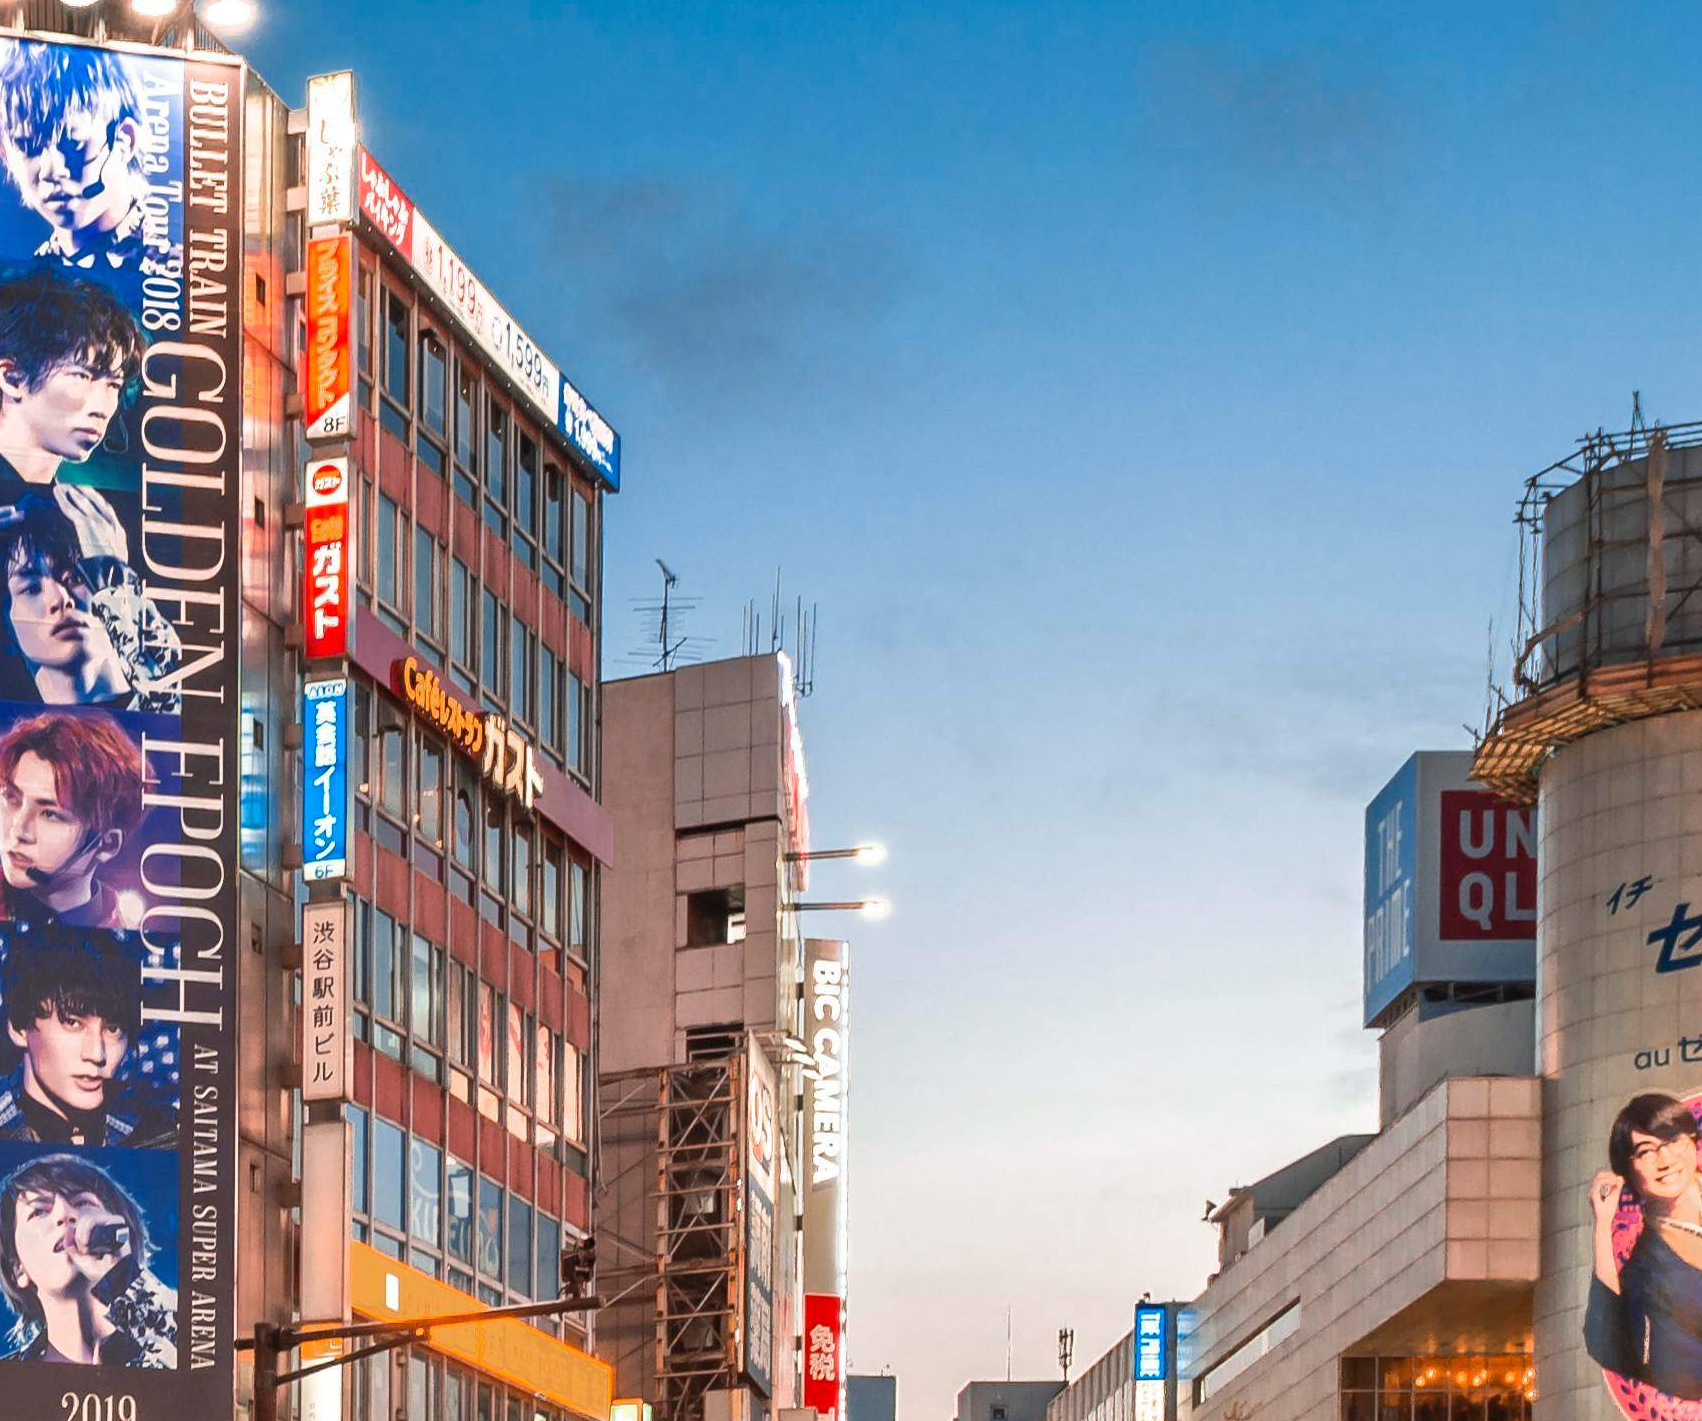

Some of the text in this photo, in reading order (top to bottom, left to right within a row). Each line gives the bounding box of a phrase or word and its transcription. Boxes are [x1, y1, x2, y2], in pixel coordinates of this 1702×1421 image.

[142, 74, 184, 333] Arena Tour 2018
[188, 76, 230, 339] BULLET TRAIN
[323, 415, 347, 434] 8F
[312, 540, 341, 640] ガスト
[139, 339, 228, 1033] GOLDEN EPOCH
[313, 700, 339, 861] 英会話イーオン
[484, 712, 545, 812] ガスト
[1367, 797, 1413, 998] THE PRIME
[1459, 809, 1539, 860] UN
[1605, 873, 1654, 916] イチ
[1459, 871, 1539, 932] QL
[312, 920, 336, 1083] 渋谷駅前ビル
[1633, 1046, 1671, 1073] au
[811, 959, 843, 1187] BIC CAMERA
[190, 1043, 220, 1372] AT SAITAMA SUPER ARENA
[809, 1322, 836, 1381] 免税
